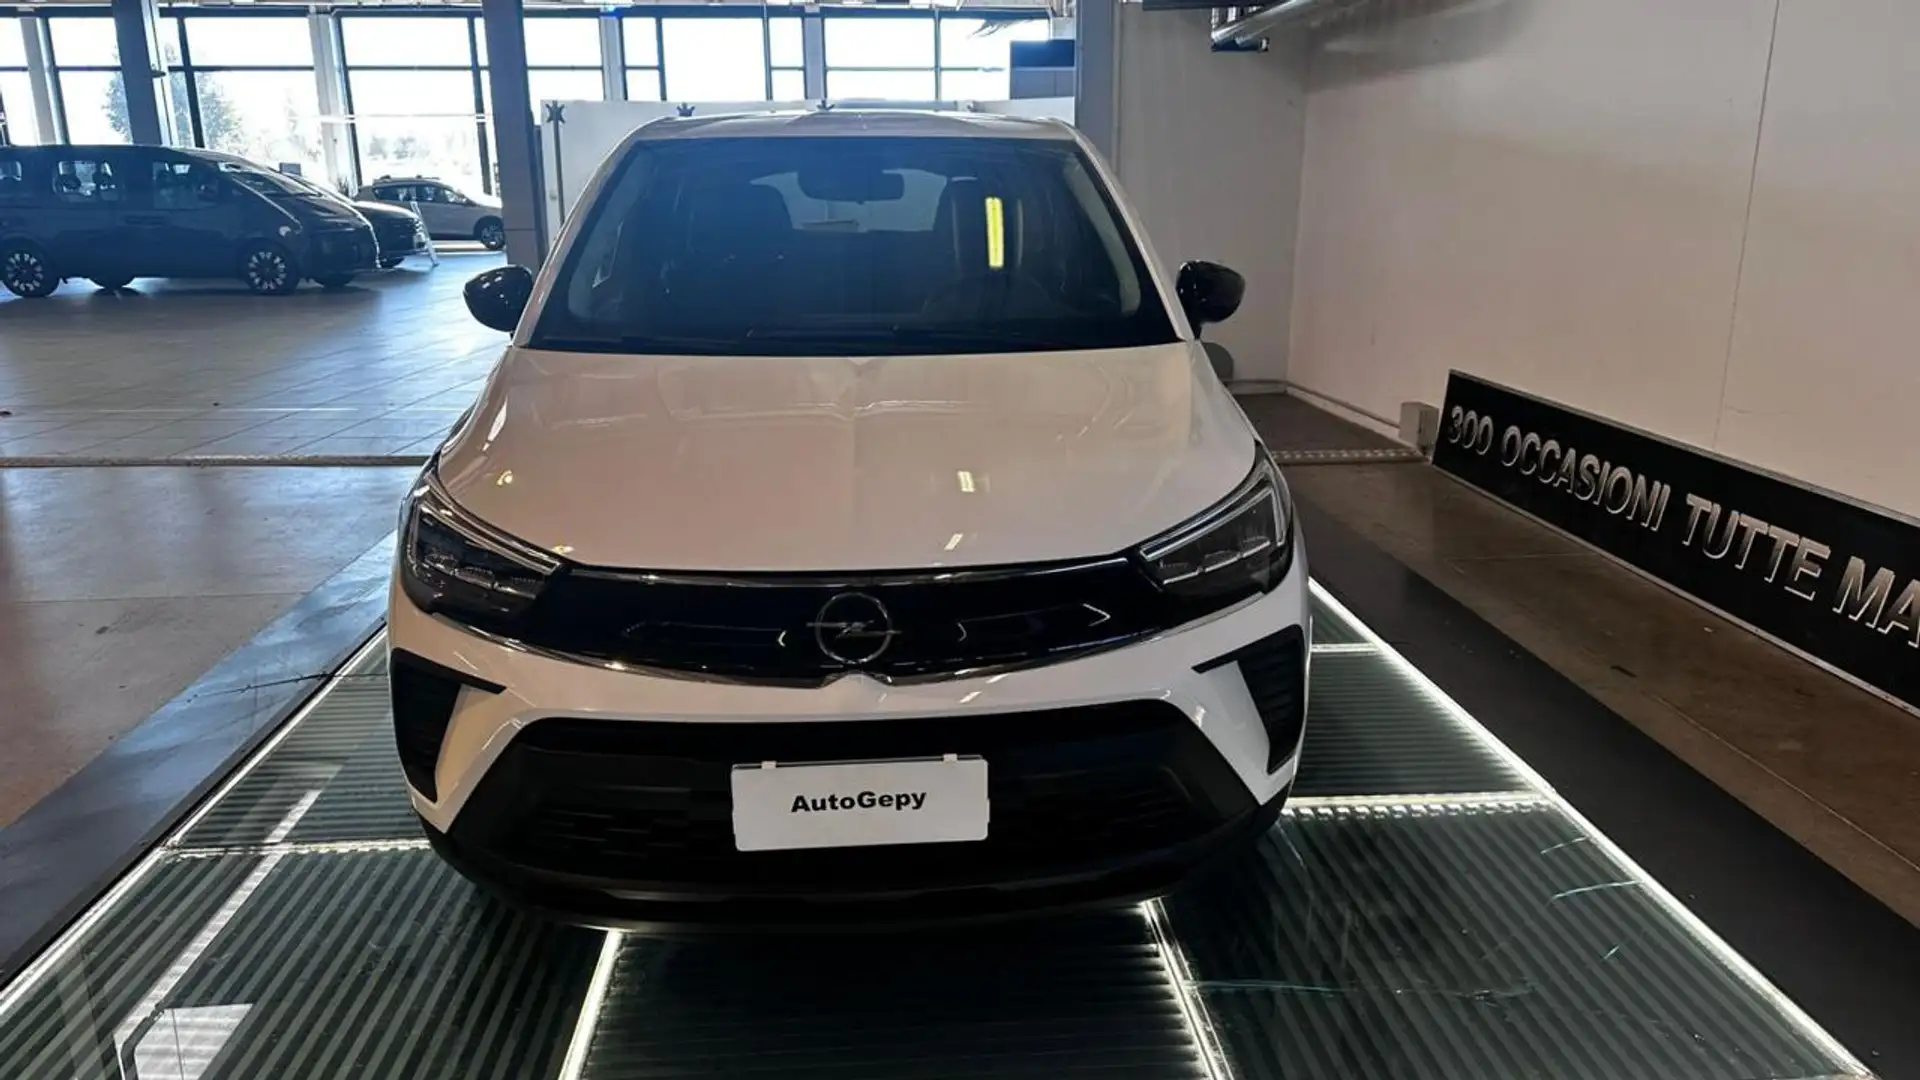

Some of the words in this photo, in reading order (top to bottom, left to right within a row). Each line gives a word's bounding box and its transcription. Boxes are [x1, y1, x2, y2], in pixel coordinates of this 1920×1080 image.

[1448, 405, 1494, 455] 300
[1501, 425, 1671, 531] OCCASIONI
[1682, 493, 1831, 601] TUTTE
[791, 791, 926, 812] AutoGepy
